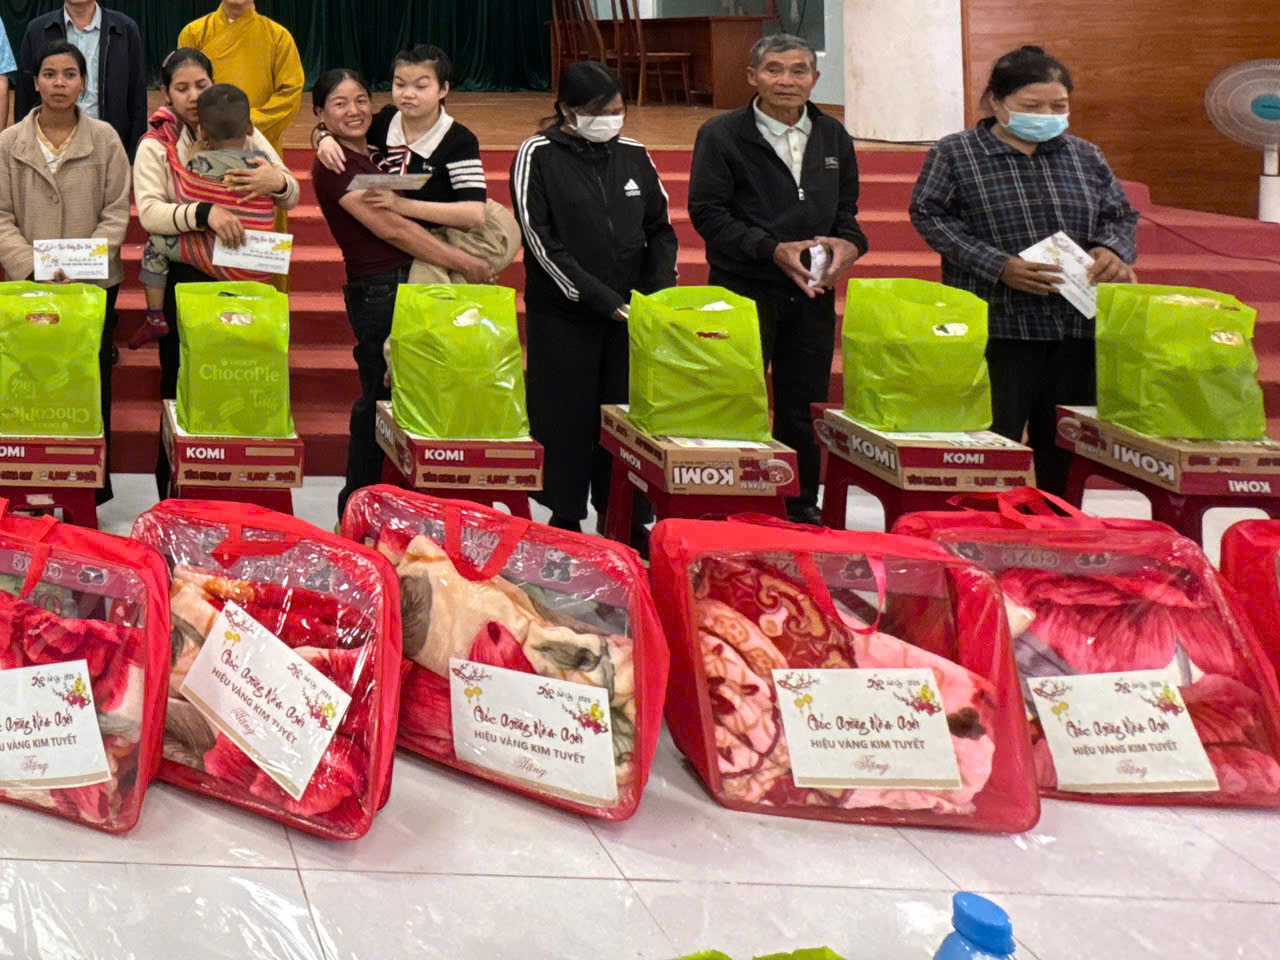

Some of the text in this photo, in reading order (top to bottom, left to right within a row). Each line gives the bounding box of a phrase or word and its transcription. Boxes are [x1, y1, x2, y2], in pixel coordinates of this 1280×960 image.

[185, 447, 226, 460] KOMI
[424, 449, 465, 462] KOMI
[851, 434, 896, 470] KOMI
[942, 452, 985, 465] KOMI
[1112, 443, 1175, 481] KOMI
[672, 466, 734, 486] KOMI
[1228, 479, 1271, 494] KOMI
[211, 667, 297, 745] HIỆU VÀNG KIM TUYẾT
[6, 739, 32, 753] VÀNG
[32, 738, 50, 750] KIM
[49, 733, 77, 749] TUYẾT
[474, 730, 586, 765] HIỆU VÀNG KIM TUYẾT
[810, 737, 926, 751] HIỆU VÀNG KIM TUYẾT
[1072, 739, 1178, 756] HIỆU VÀNG KIM TUYẾT
